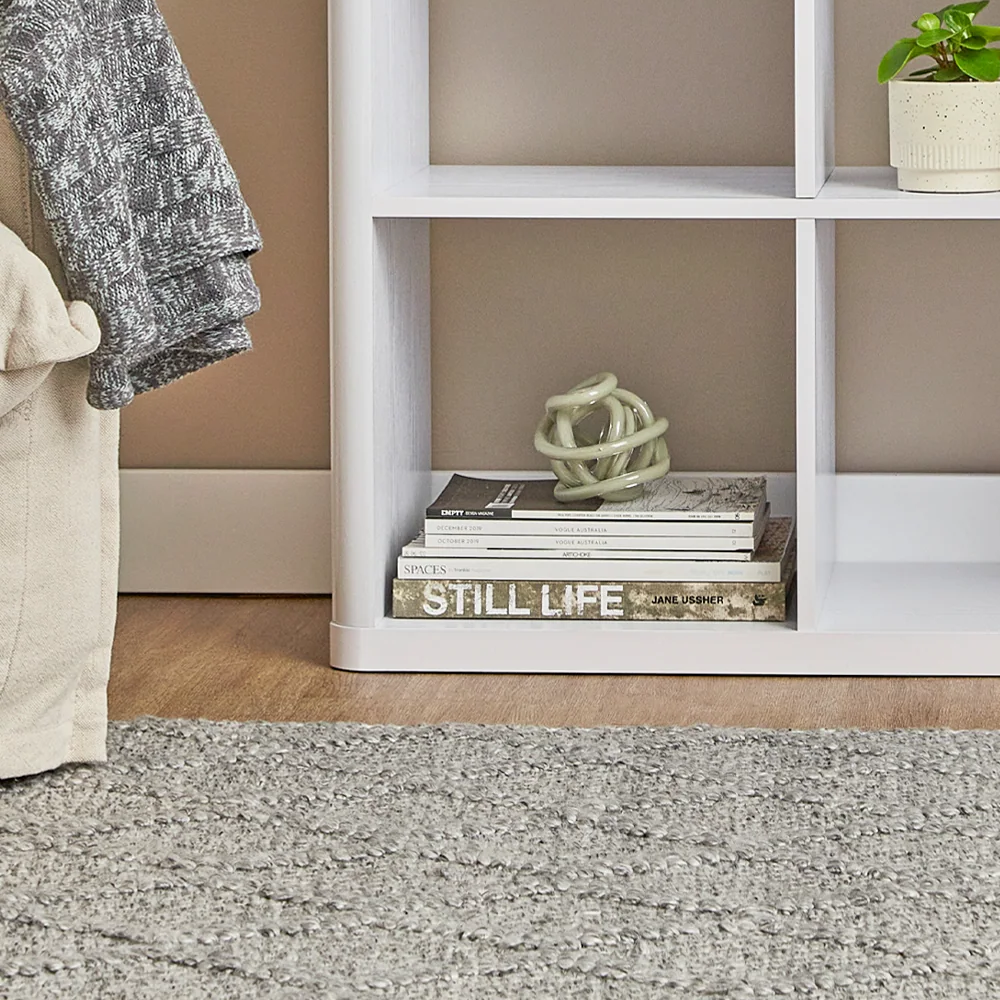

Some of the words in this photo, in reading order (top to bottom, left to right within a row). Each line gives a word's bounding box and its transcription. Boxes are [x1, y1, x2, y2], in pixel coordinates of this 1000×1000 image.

[403, 564, 447, 575] SPACES
[422, 583, 530, 616] STILL
[541, 584, 624, 617] LIFE
[651, 595, 679, 605] JANE
[681, 595, 724, 605] USSHER
